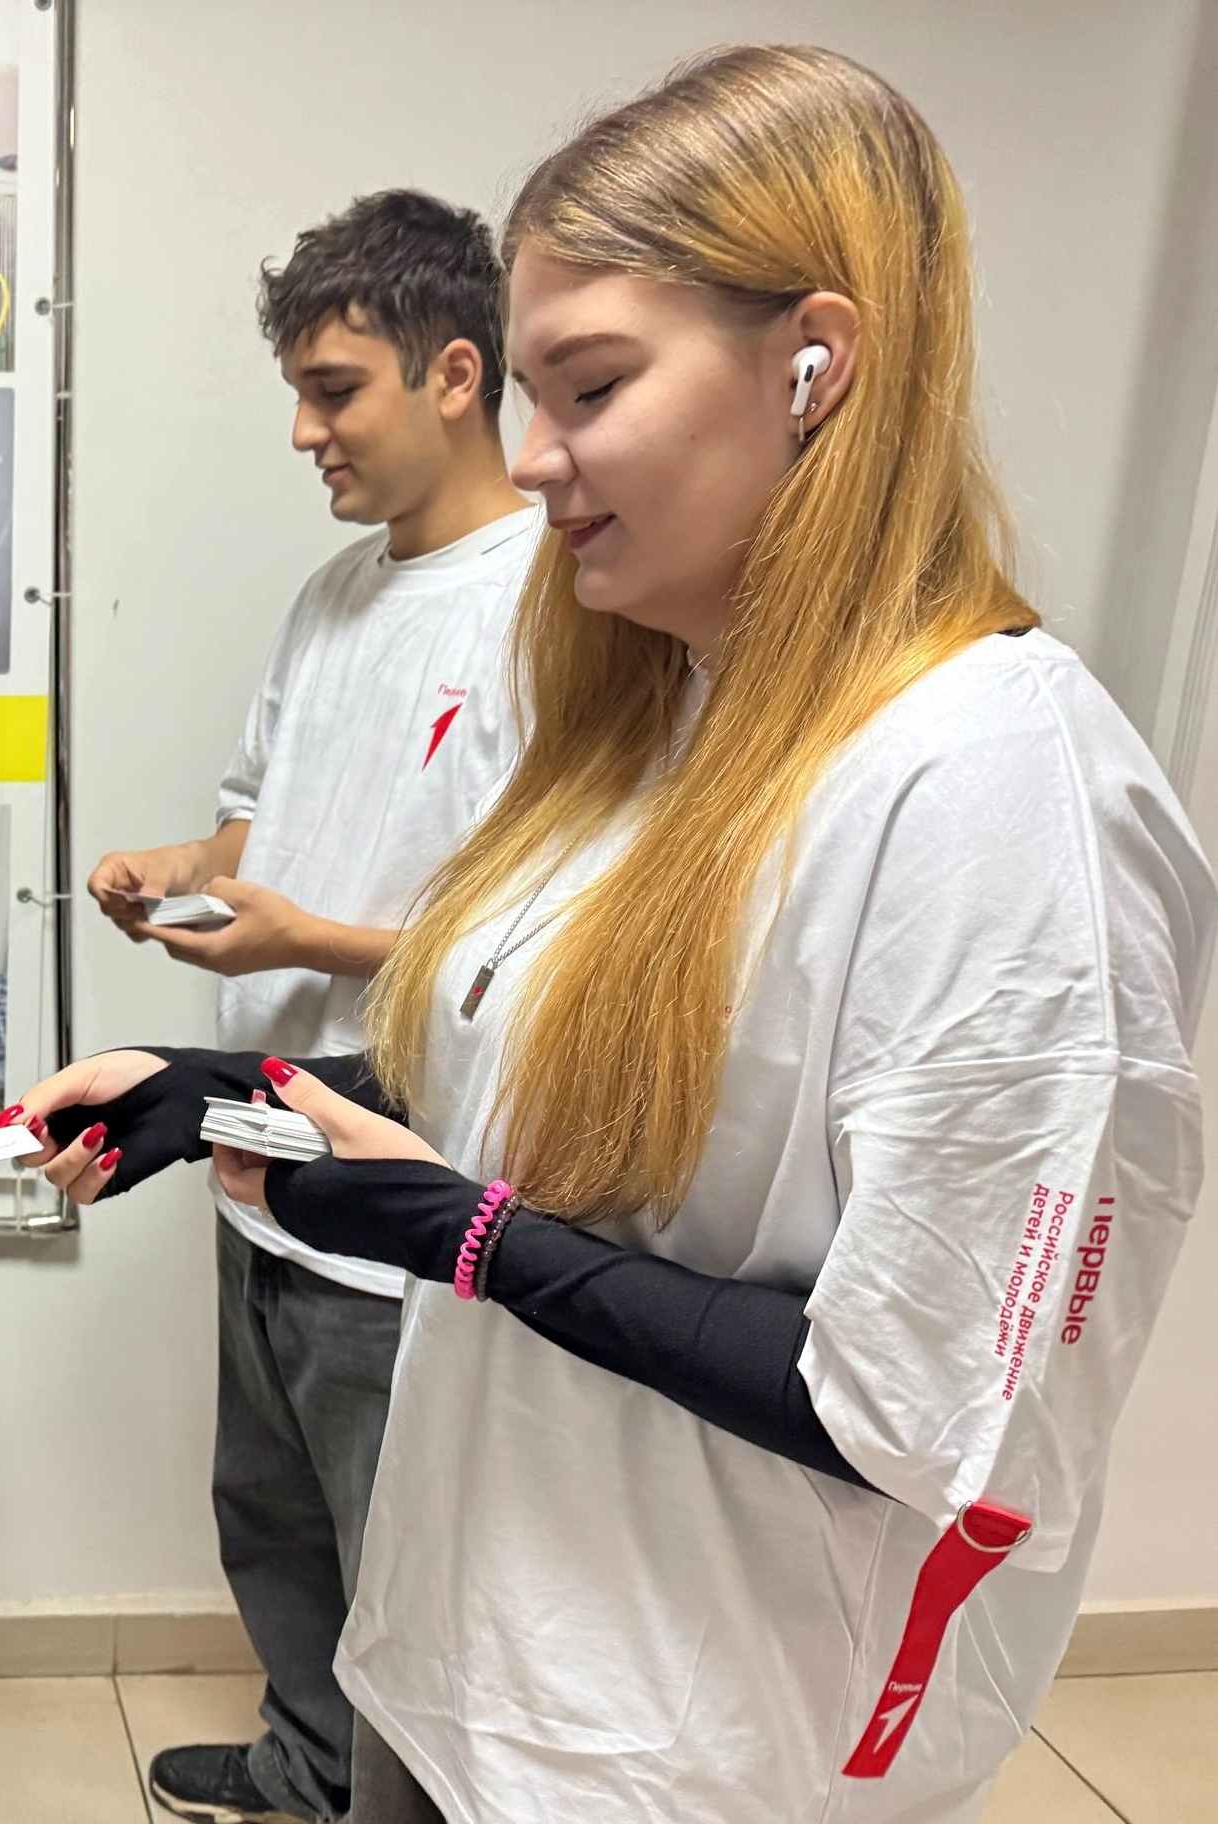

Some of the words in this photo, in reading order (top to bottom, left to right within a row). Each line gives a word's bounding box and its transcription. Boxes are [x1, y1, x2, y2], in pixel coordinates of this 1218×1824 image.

[1019, 1243, 1033, 1258] и
[1023, 1183, 1050, 1241] детей
[1027, 1190, 1075, 1304] Российское
[994, 1260, 1029, 1357] молодёжи
[1002, 1304, 1036, 1401] движение
